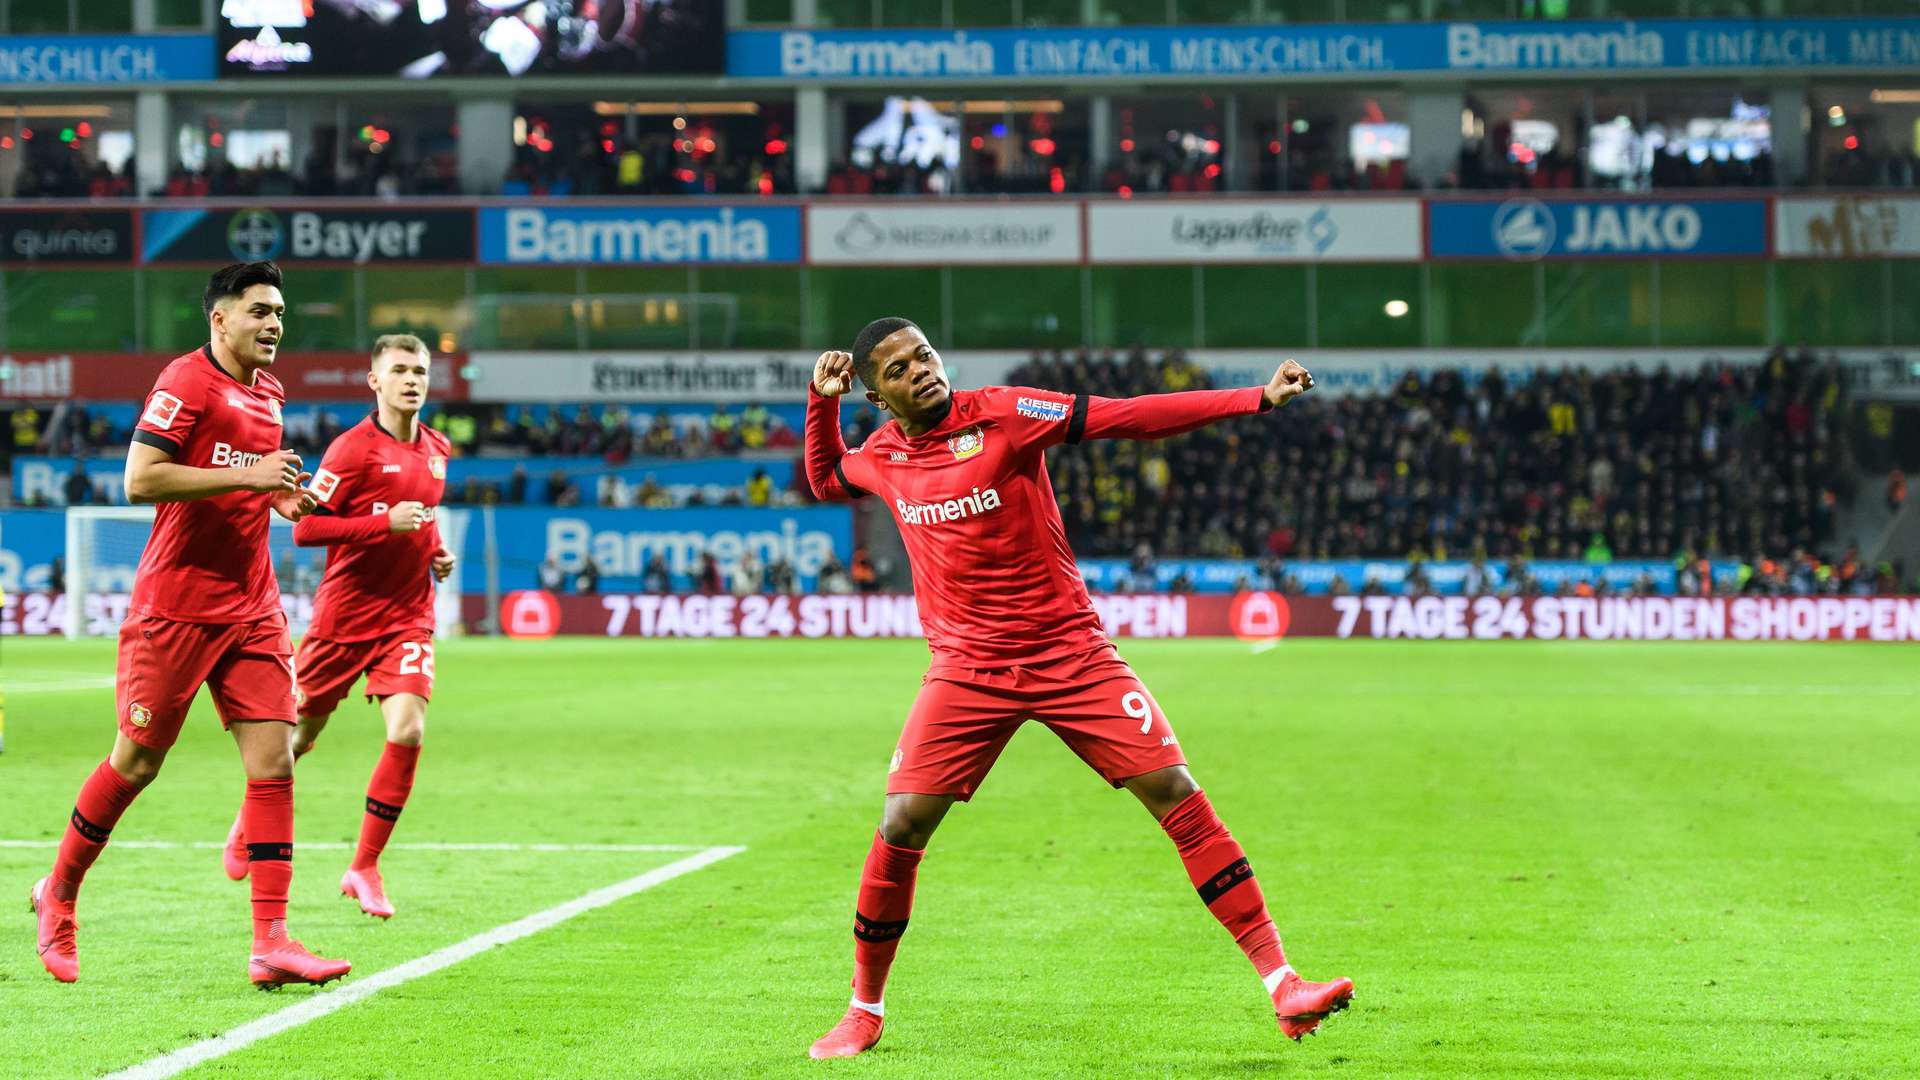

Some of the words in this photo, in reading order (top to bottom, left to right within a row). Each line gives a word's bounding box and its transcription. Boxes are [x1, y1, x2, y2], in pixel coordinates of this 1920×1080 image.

[781, 31, 995, 75] Barmenia
[1447, 22, 1664, 67] Barmenia
[291, 211, 427, 264] Bayer
[505, 207, 768, 262] Barmenia
[1566, 206, 1700, 250] JAKO
[1017, 407, 1066, 422] TRAININ
[211, 442, 263, 469] Barm
[896, 487, 1000, 525] Barmenia
[546, 519, 833, 578] Barmenia
[602, 595, 631, 636] 7
[634, 595, 736, 636] TAGE
[740, 595, 796, 636] 24
[798, 595, 923, 637] STUN
[1333, 597, 1362, 638] 7
[1364, 597, 1468, 638] TAGE
[1472, 597, 1529, 638] 24
[1532, 597, 1725, 639] STUNDEN
[1730, 597, 1920, 640] SHOPPEN
[400, 642, 434, 680] 22
[1121, 691, 1152, 735] 9
